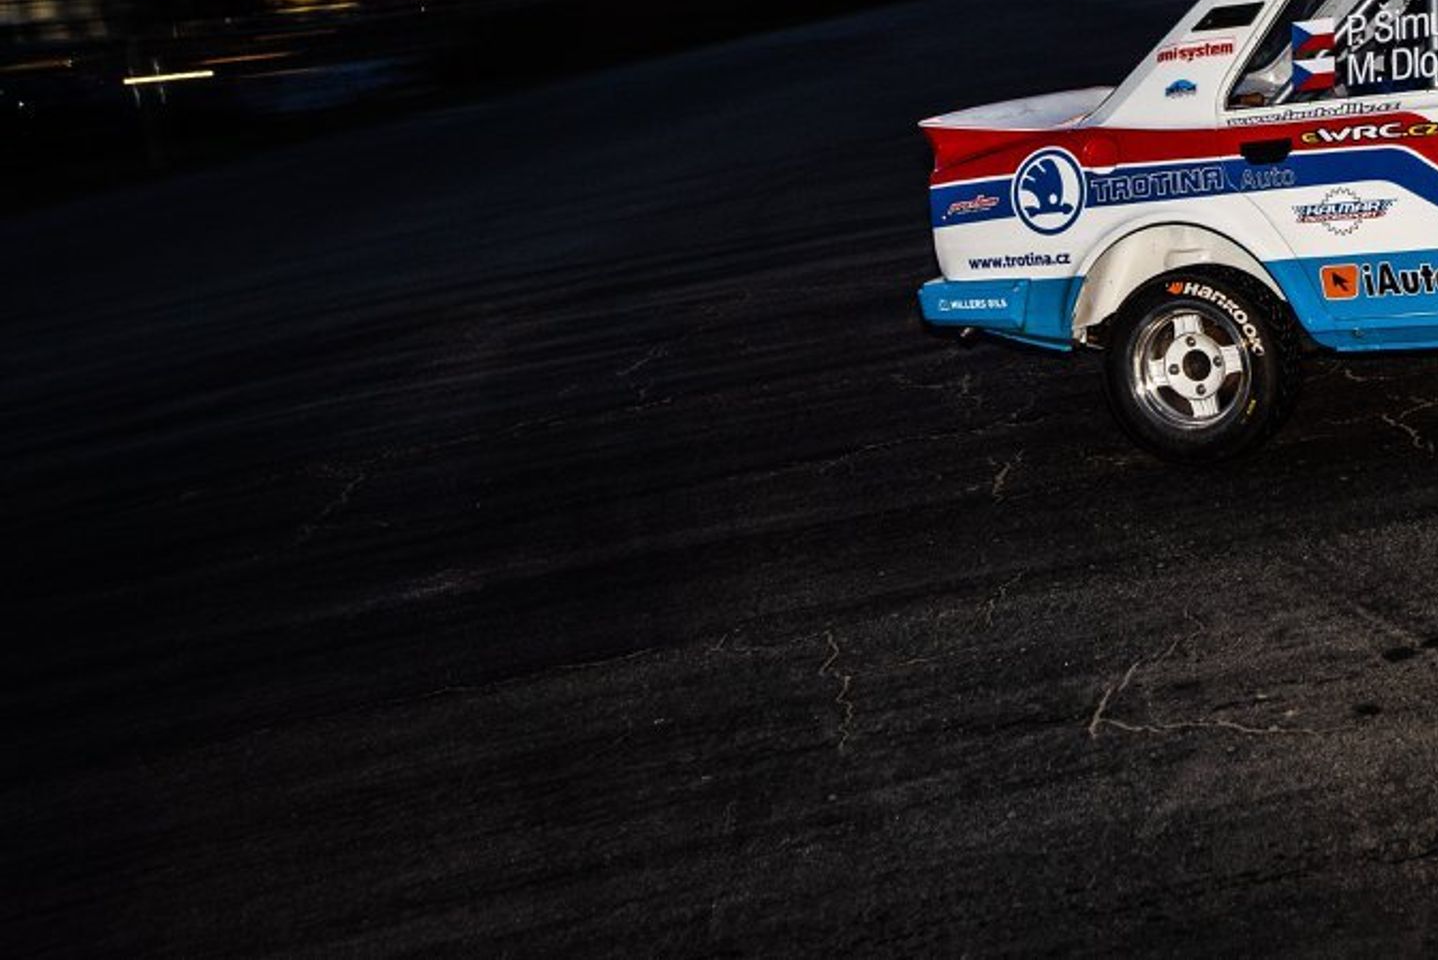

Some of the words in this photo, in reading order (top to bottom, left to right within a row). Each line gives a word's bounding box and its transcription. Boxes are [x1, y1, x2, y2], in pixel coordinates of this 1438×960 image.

[1348, 51, 1383, 85] M.
[1090, 166, 1226, 202] TROTINA
[1239, 165, 1296, 190] Auto
[968, 251, 1072, 270] www.trotina.cz
